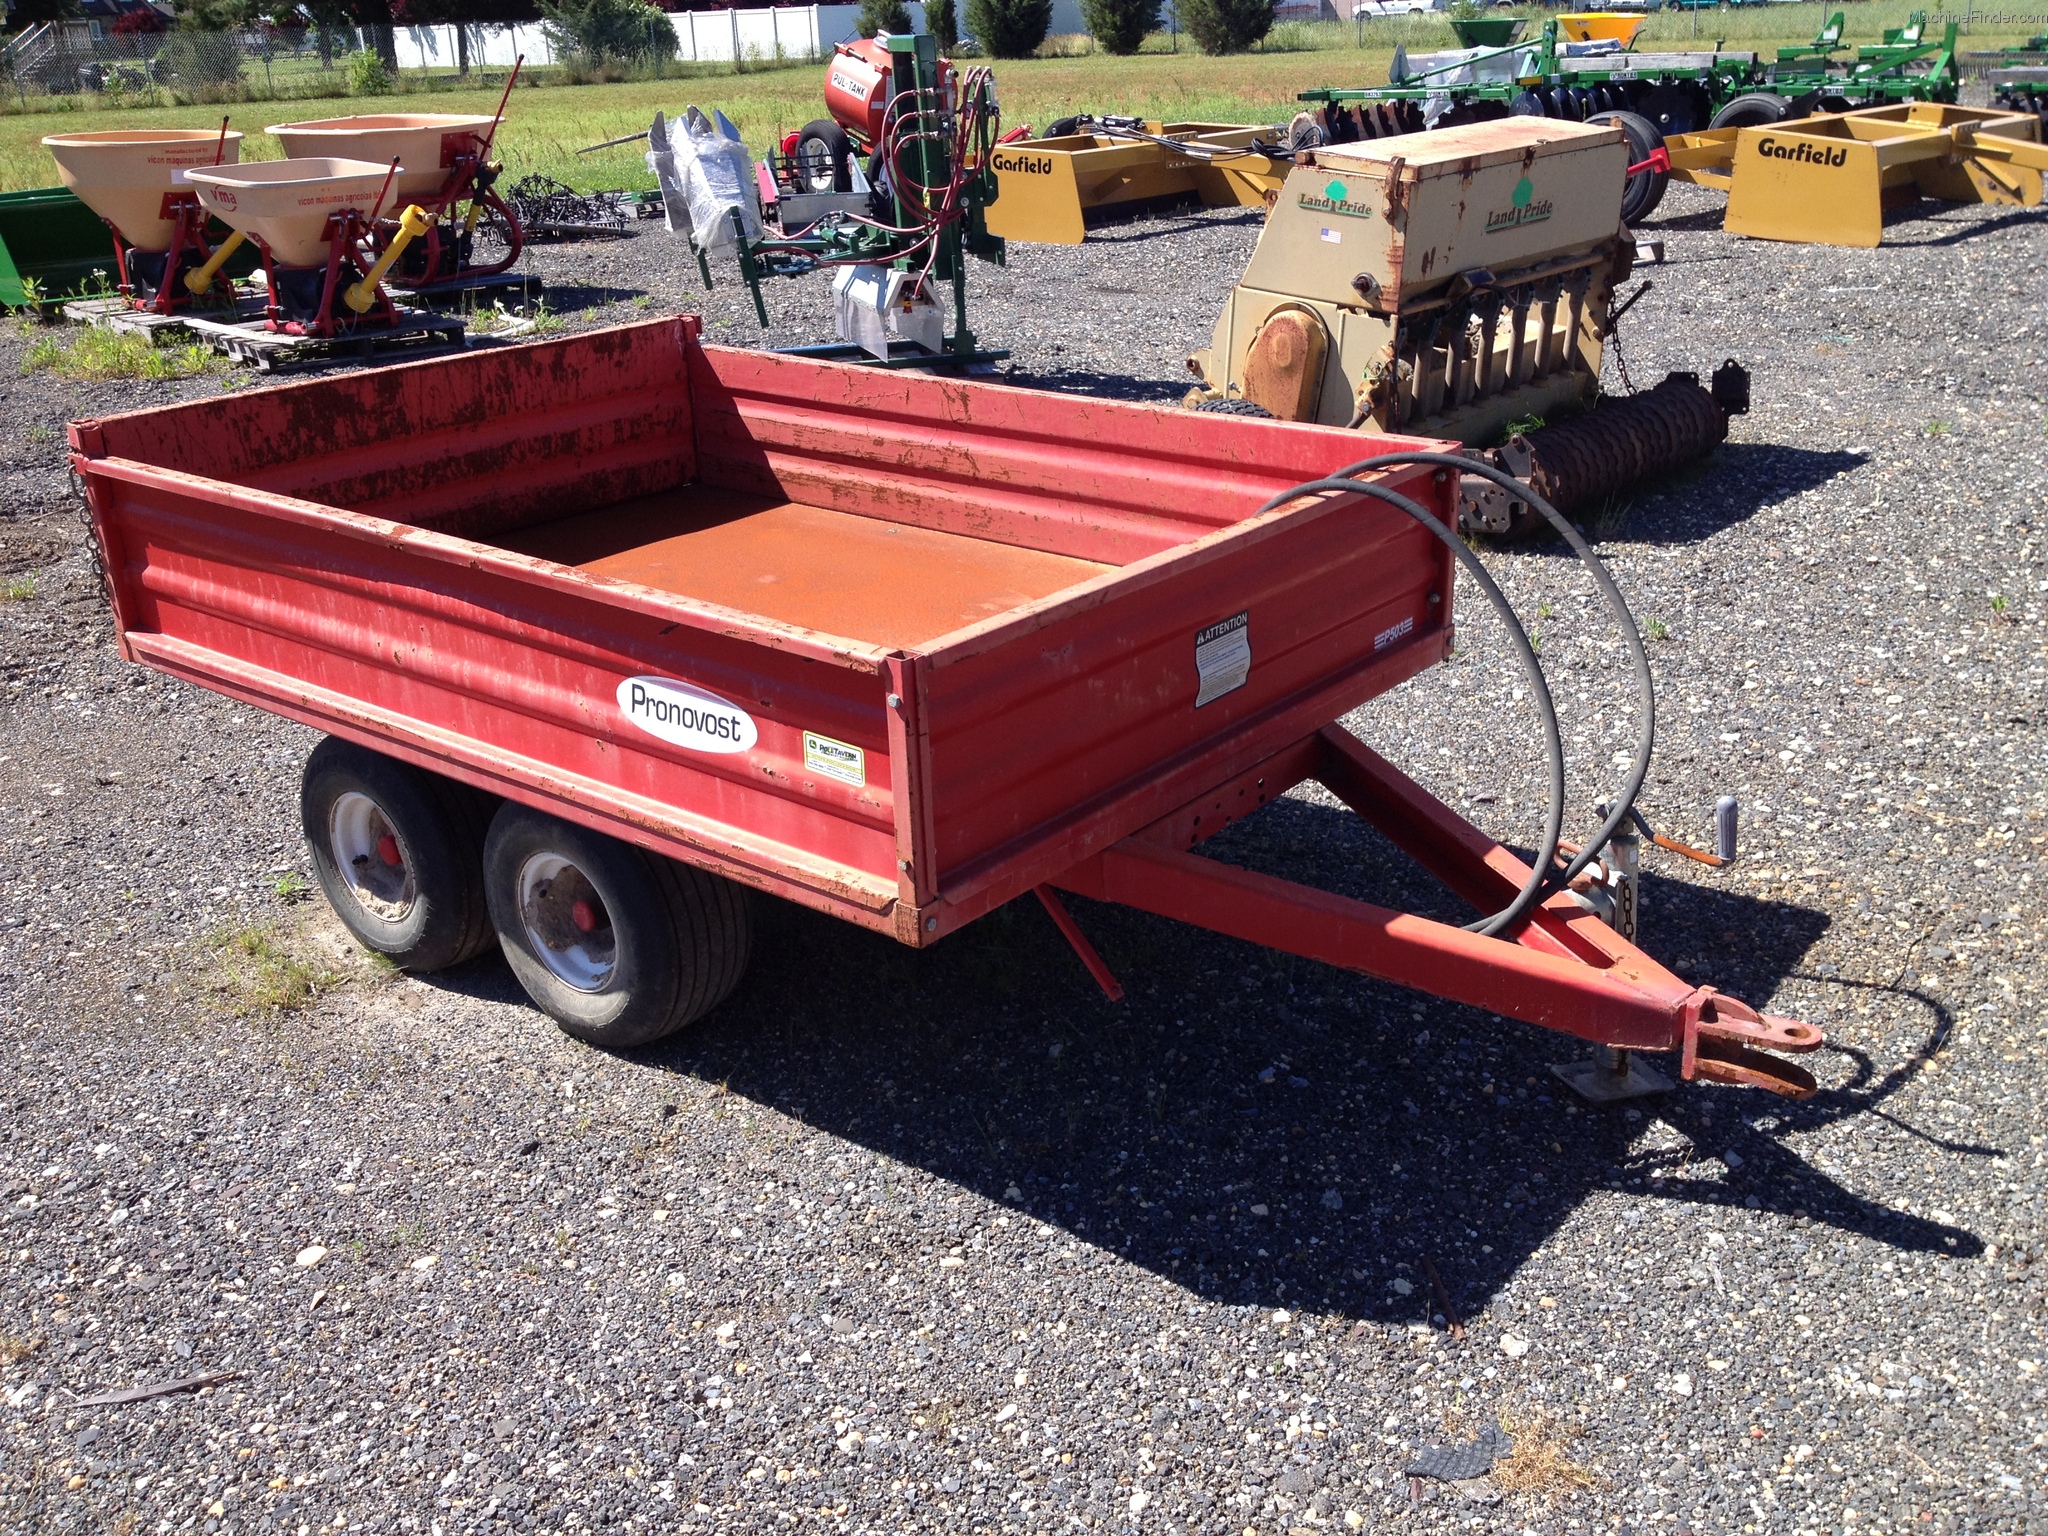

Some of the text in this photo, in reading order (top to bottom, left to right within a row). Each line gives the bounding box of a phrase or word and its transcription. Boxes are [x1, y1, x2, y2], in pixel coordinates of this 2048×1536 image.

[992, 153, 1052, 175] Garfield
[1758, 137, 1848, 168] Garfield
[210, 189, 238, 205] vma
[1299, 193, 1372, 215] Land Pride
[1486, 199, 1553, 228] Land Pride
[1204, 611, 1248, 641] ATTENTION
[631, 682, 741, 742] Pronovost
